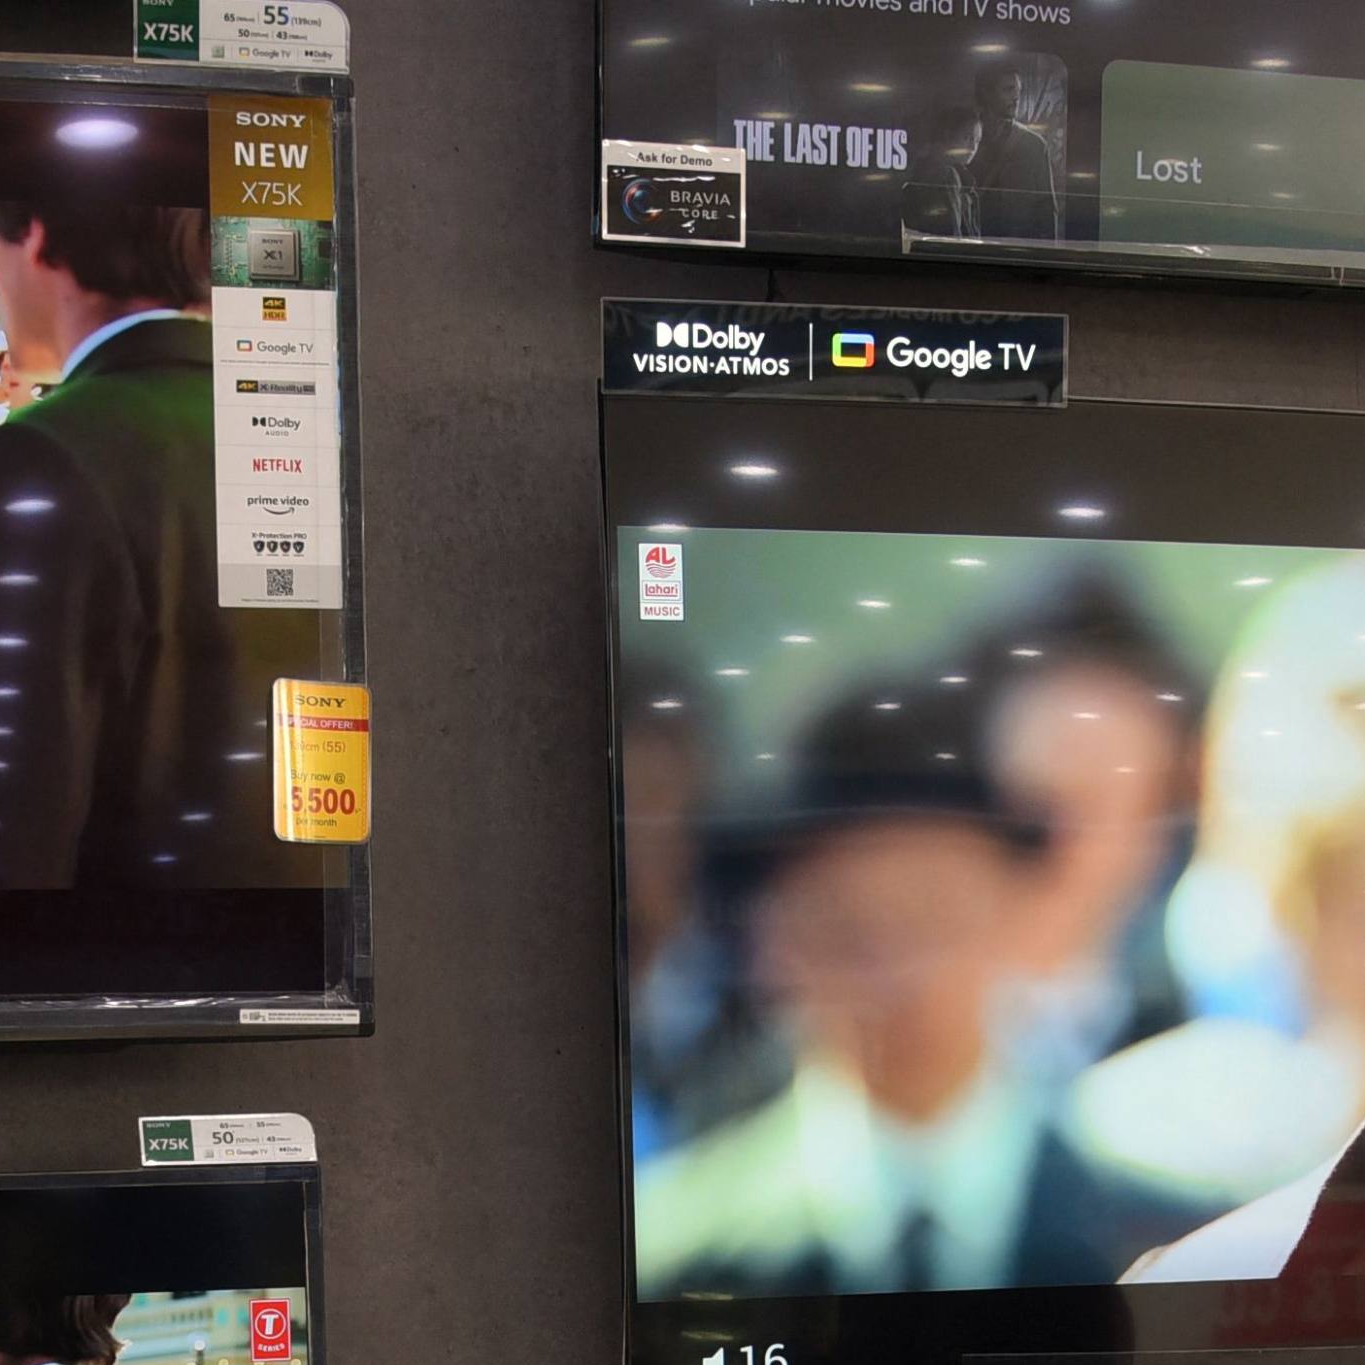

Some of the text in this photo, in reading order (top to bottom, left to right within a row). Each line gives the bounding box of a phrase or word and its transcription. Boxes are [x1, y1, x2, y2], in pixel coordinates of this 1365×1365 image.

[223, 13, 235, 22] 65
[263, 6, 289, 25] 55
[909, 0, 954, 16] and
[962, 0, 988, 17] TV
[995, 2, 1071, 25] shows
[143, 22, 194, 43] X75K
[238, 30, 250, 39] 50
[276, 30, 288, 39] 43
[252, 48, 291, 59] Google TV
[236, 111, 306, 128] SONY
[734, 118, 909, 171] THE LAST OF US
[234, 141, 309, 169] NEW
[636, 152, 713, 166] Ask for Demo
[1136, 151, 1203, 184] Lost
[241, 181, 302, 206] X75K
[670, 191, 731, 206] BRAVIA
[682, 210, 718, 220] CORE
[692, 323, 765, 357] Dolby
[257, 341, 314, 356] Google TV
[886, 336, 1036, 378] Google TV
[268, 417, 300, 430] Dolby
[253, 458, 302, 473] NETFLIX
[247, 496, 309, 506] prime video
[644, 606, 680, 616] MUSIC
[295, 695, 345, 708] SONY
[291, 769, 345, 785] Buy now @
[149, 1138, 189, 1151] X75K
